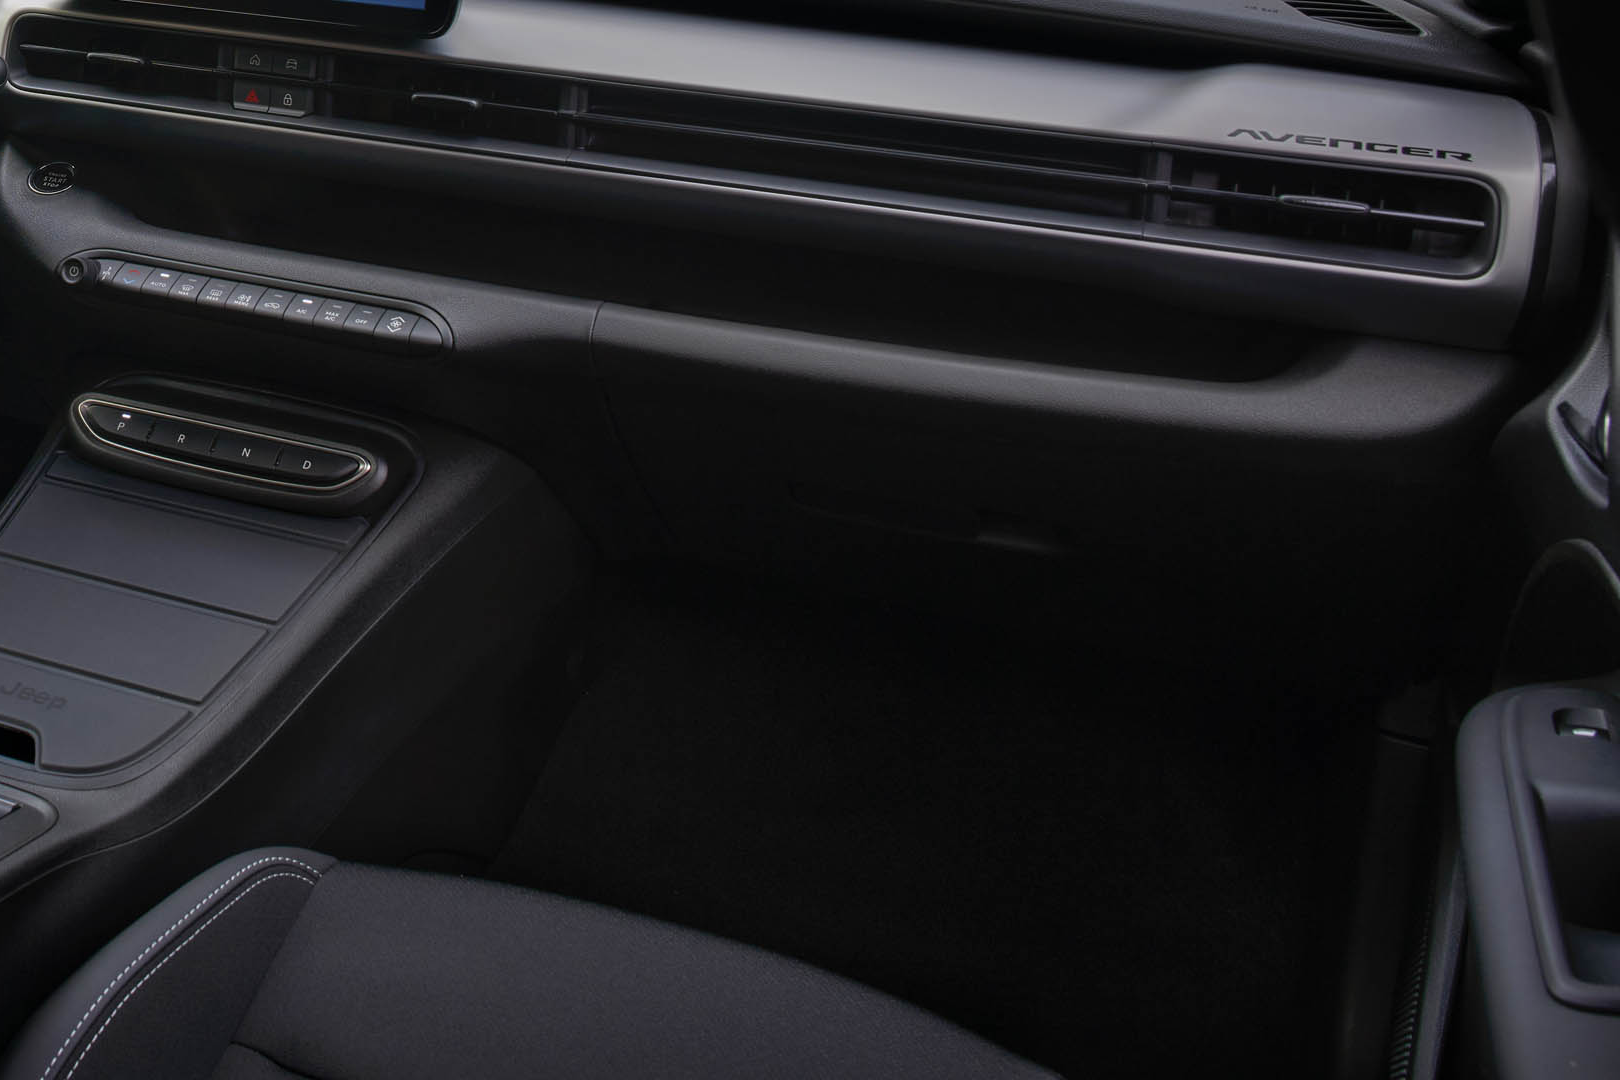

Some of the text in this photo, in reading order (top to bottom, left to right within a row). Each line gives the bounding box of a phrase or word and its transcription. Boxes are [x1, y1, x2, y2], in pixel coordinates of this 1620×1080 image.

[1227, 128, 1473, 163] AVENGER
[43, 175, 68, 184] START
[150, 280, 167, 288] AUTO
[116, 422, 125, 431] P
[177, 433, 186, 443] R
[241, 447, 251, 457] N
[302, 459, 312, 470] D
[0, 680, 68, 711] Jeep
